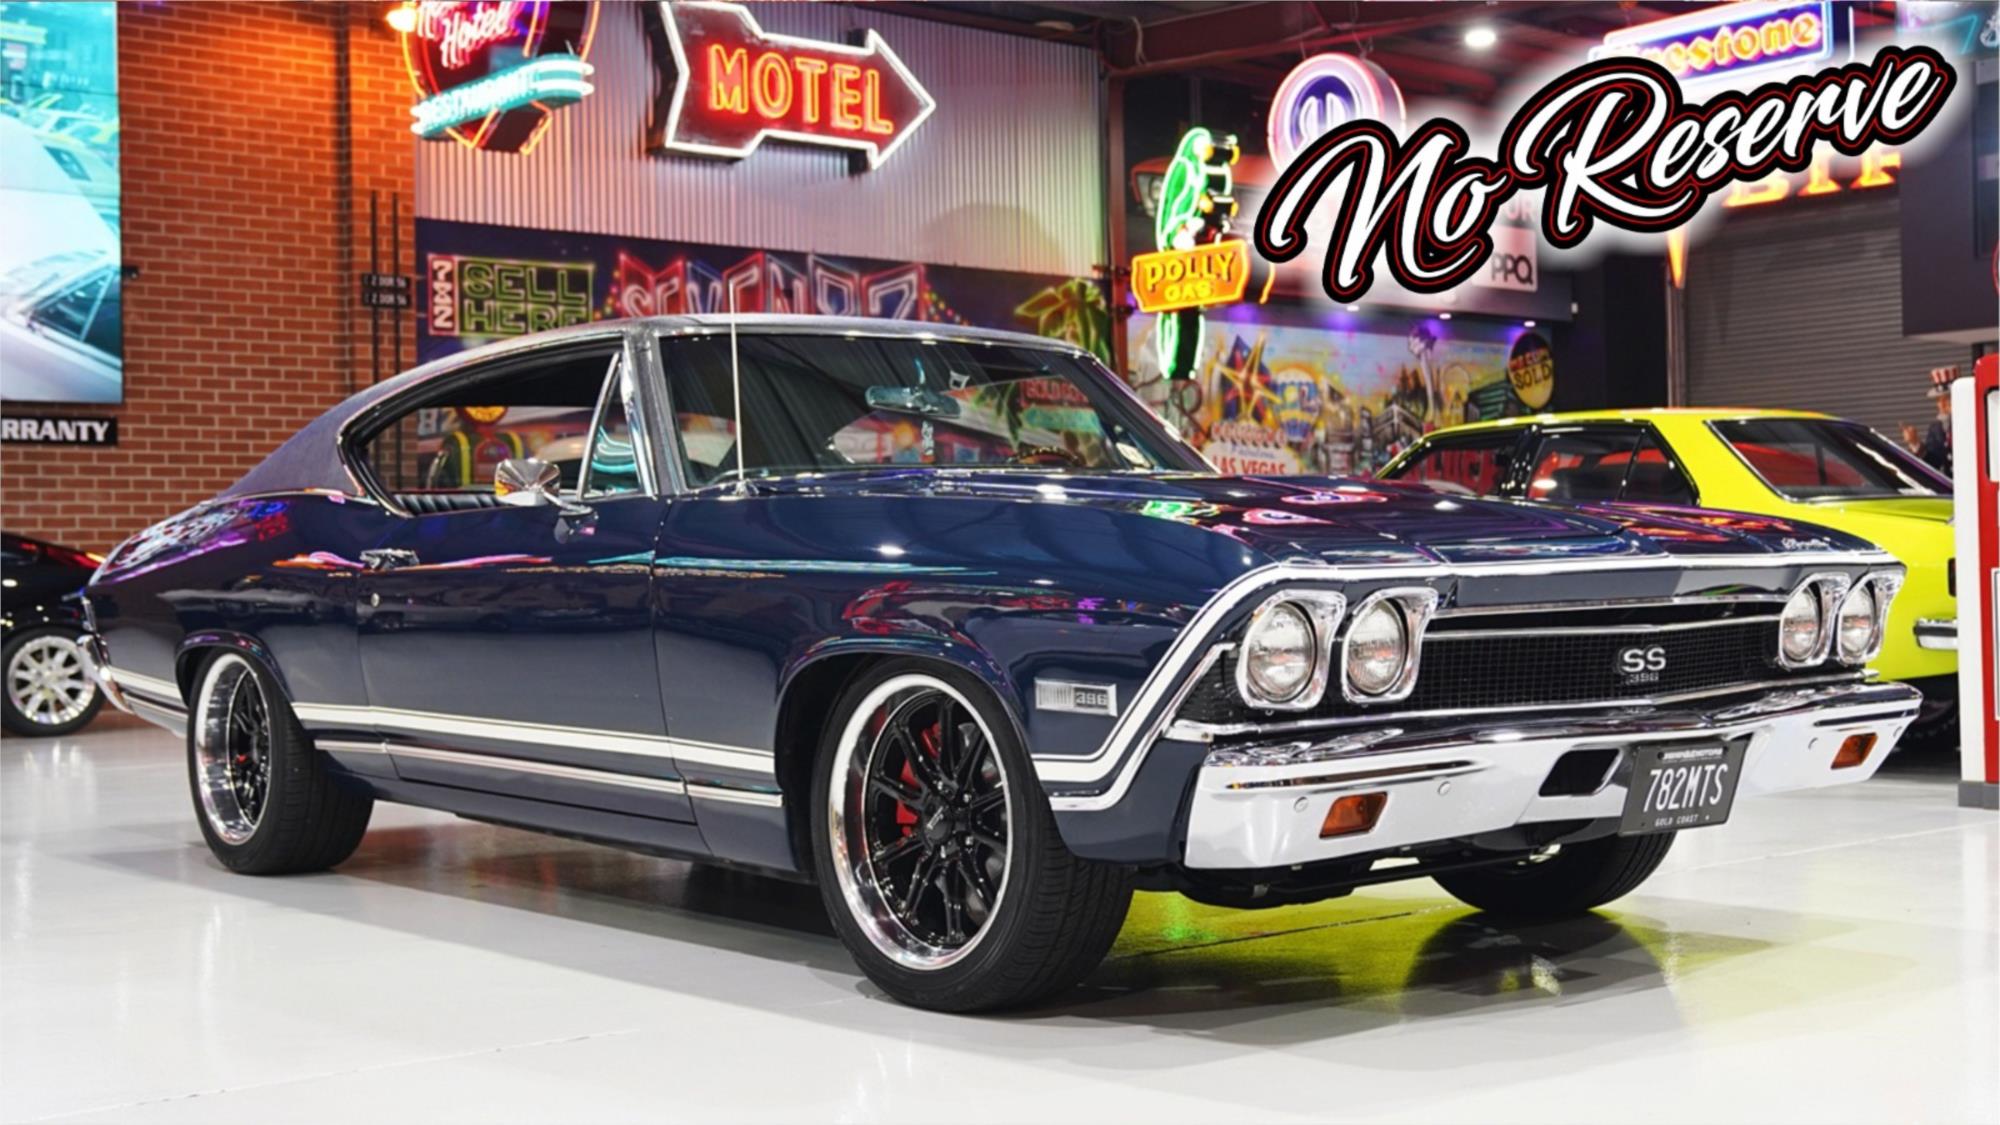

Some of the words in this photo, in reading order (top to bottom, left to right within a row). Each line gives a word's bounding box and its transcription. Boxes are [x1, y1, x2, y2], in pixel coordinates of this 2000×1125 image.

[708, 43, 895, 135] MOTEL
[463, 263, 588, 306] SELL
[1144, 251, 1237, 292] POLLY
[1492, 251, 1534, 285] PPQ
[1164, 281, 1212, 302] GAS
[463, 300, 588, 334] HERE
[1514, 363, 1552, 390] SOLD
[0, 418, 109, 442] RRANTY
[1241, 458, 1287, 475] VEGAS
[1621, 647, 1667, 673] SS
[1643, 763, 1729, 813] 782MTS
